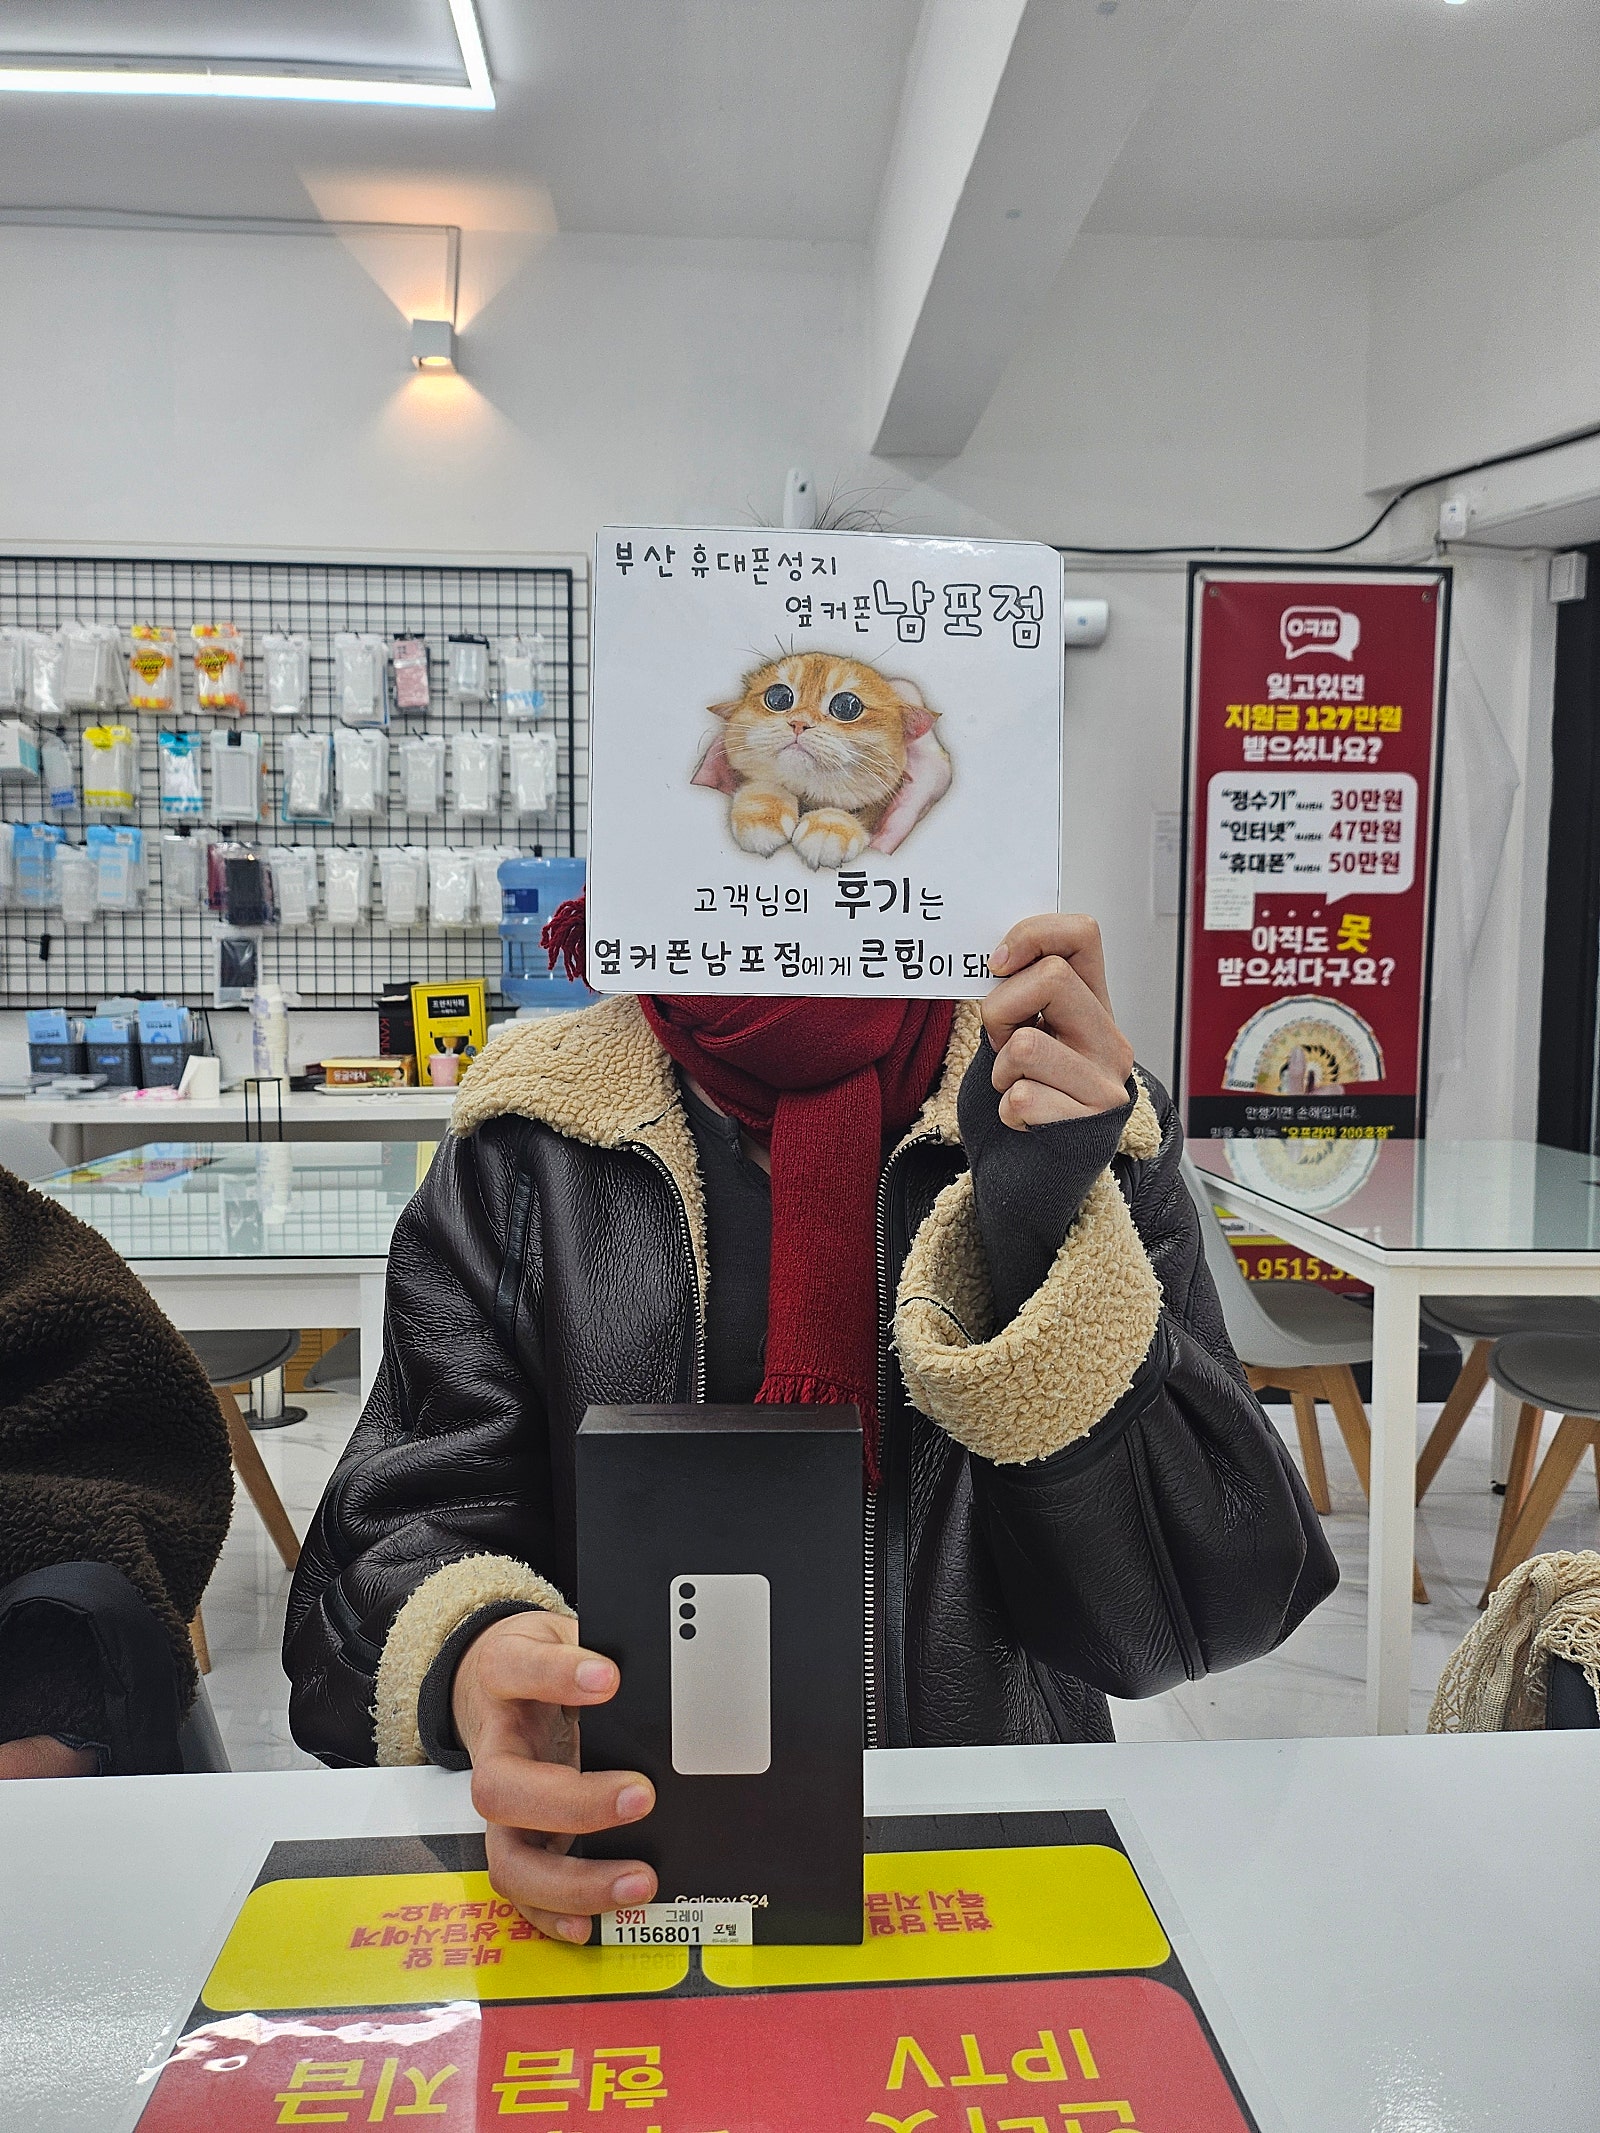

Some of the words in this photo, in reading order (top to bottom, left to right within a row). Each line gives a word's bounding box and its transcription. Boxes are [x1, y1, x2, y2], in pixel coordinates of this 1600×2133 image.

[615, 541, 676, 578] 부산
[691, 543, 837, 586] 휴대폰성지
[1266, 673, 1365, 701] 잊고있던
[1224, 704, 1300, 731] 지원금
[1304, 705, 1402, 732] 127만원
[1242, 735, 1383, 764] 받으셨나요?
[1331, 789, 1403, 812] 30만원
[1328, 820, 1402, 843] 47만원
[1328, 851, 1401, 874] 50만원
[694, 884, 808, 917] 고객님의
[834, 871, 944, 920] 후기는
[1252, 926, 1330, 954] 아직도
[1336, 913, 1372, 954] 못
[963, 953, 1011, 979] 돼
[1217, 957, 1396, 987] 받으셨다구요?
[380, 1018, 390, 1055] KANU
[865, 1892, 921, 1913] 지급
[928, 1890, 985, 1910] 즉시
[615, 1910, 646, 1925] S921
[665, 1909, 703, 1923] 그레이
[713, 1923, 737, 1936] 오텔
[868, 1914, 926, 1935] 당일
[933, 1911, 992, 1932] 현금
[350, 1921, 500, 1949] 상담사에게
[615, 1926, 700, 1943] 1156801
[402, 1947, 433, 1970] 앞
[443, 1945, 502, 1966] 바로
[886, 2028, 1100, 2091] IPTV
[274, 2059, 460, 2125] 지급
[491, 2046, 669, 2115] 현금
